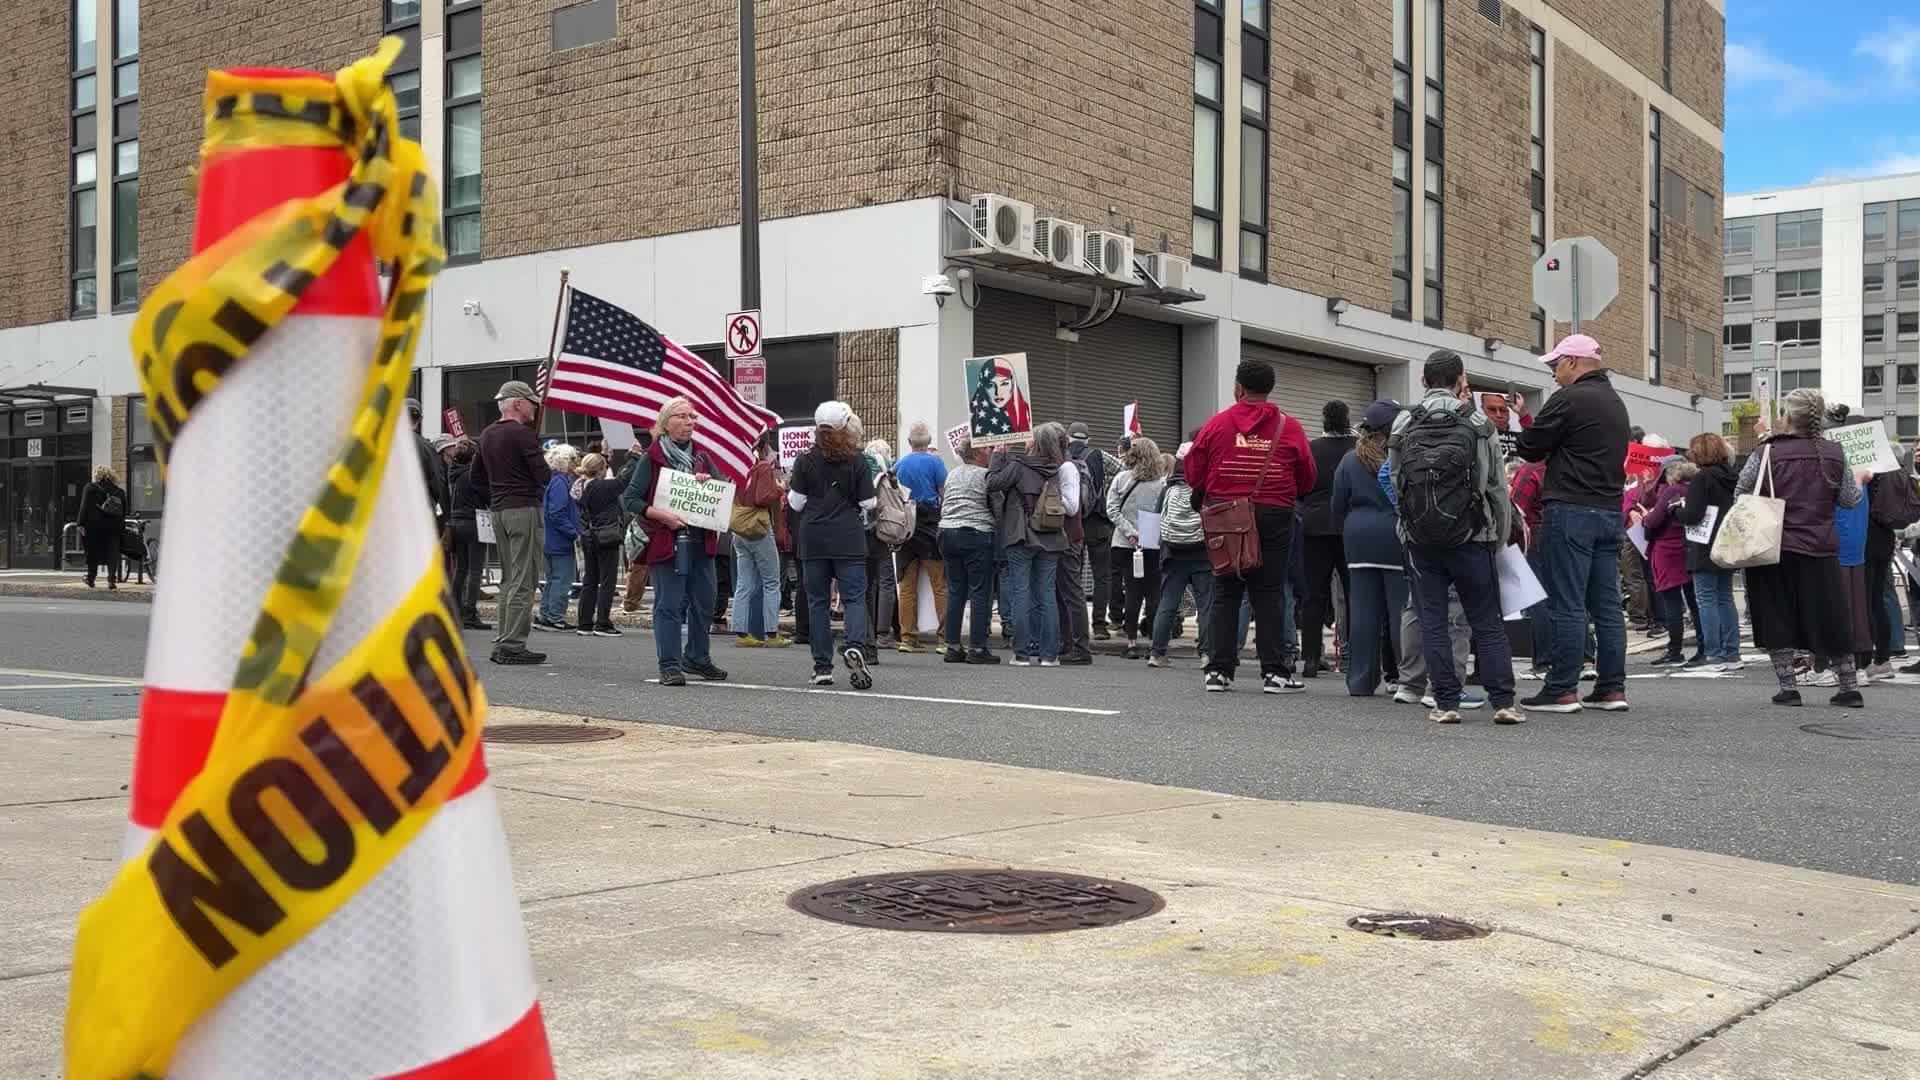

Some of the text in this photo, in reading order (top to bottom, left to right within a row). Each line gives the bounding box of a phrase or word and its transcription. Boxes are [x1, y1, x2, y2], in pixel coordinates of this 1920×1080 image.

[782, 431, 811, 440] HONK
[948, 425, 969, 440] STOP
[1829, 426, 1873, 441] Love your
[782, 440, 809, 449] YOUR
[1842, 440, 1874, 455] eighbor
[1849, 452, 1878, 466] CEout
[671, 472, 726, 493] Love your
[670, 487, 722, 505] neighbor
[670, 498, 717, 518] #ICEout
[147, 605, 477, 971] UTION
